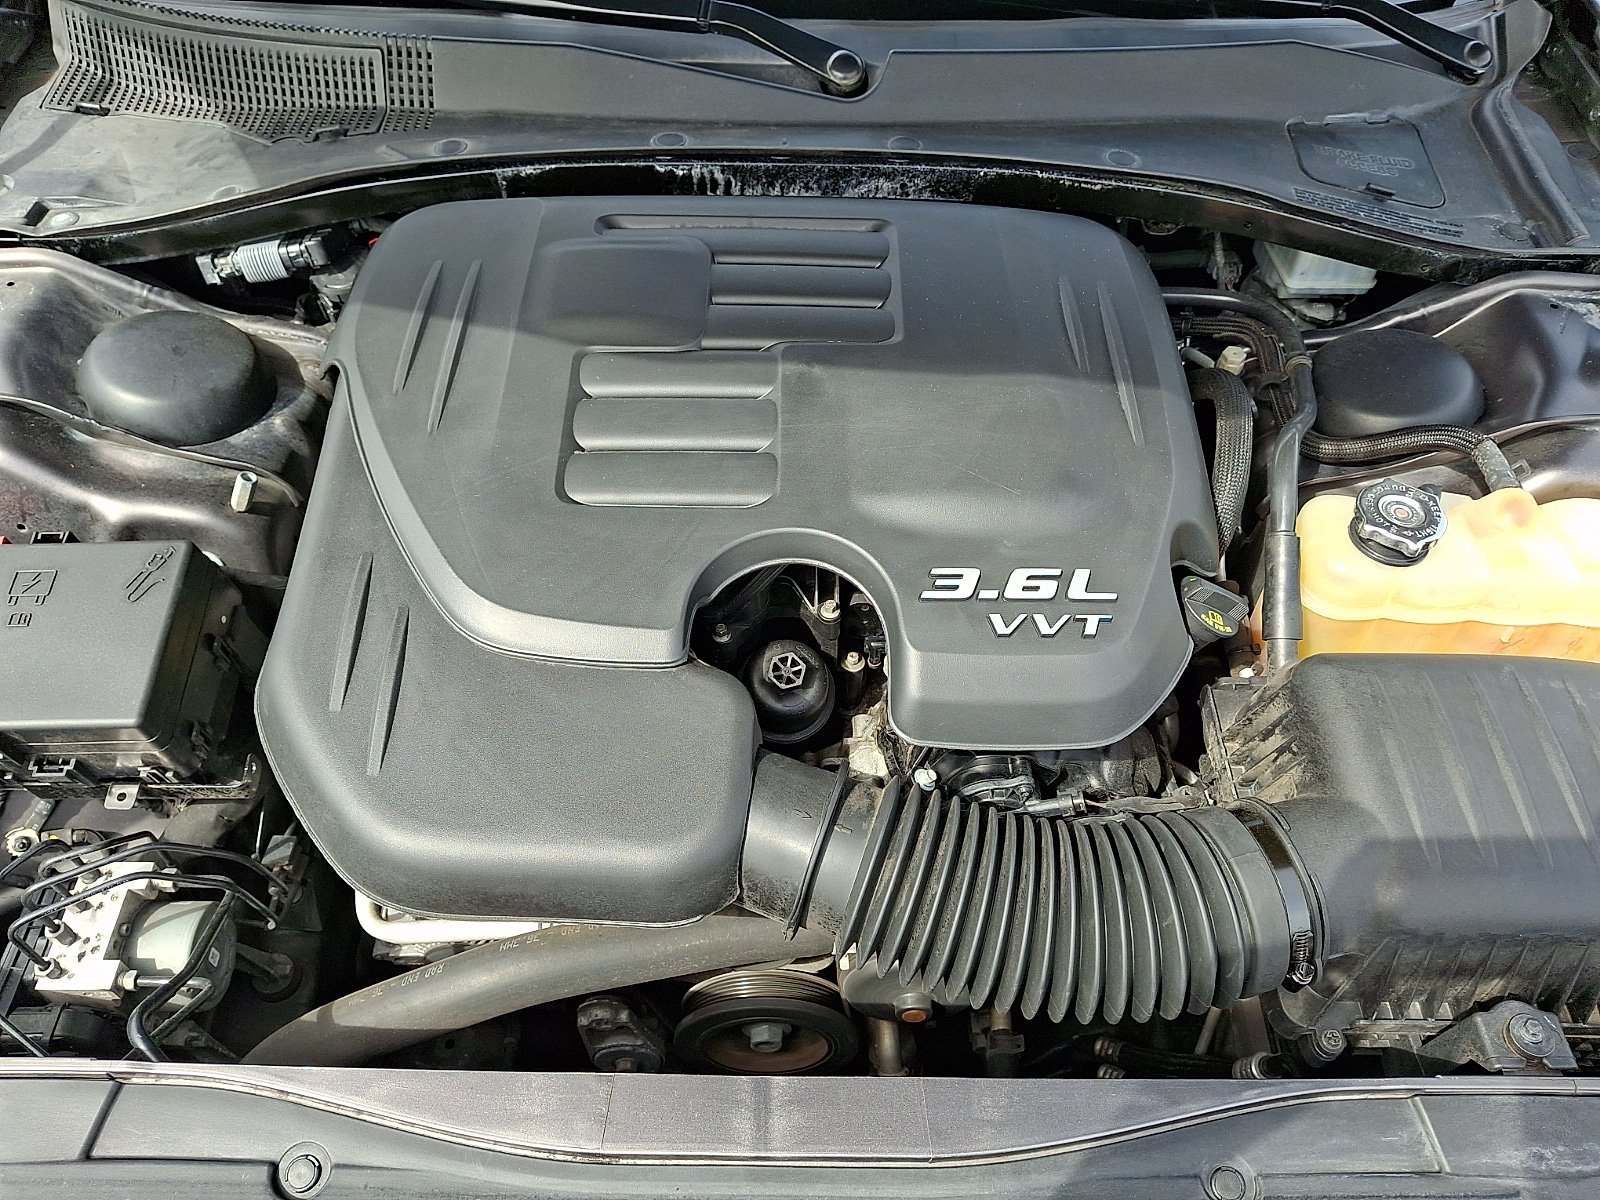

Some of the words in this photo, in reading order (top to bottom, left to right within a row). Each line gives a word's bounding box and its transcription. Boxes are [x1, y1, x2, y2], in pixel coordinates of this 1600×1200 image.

[1312, 144, 1363, 160] BRAKE
[1364, 153, 1415, 169] FLUID
[919, 567, 1118, 602] 3.6L
[987, 613, 1113, 639] VVT
[401, 972, 420, 987] END
[424, 963, 445, 978] RAD
